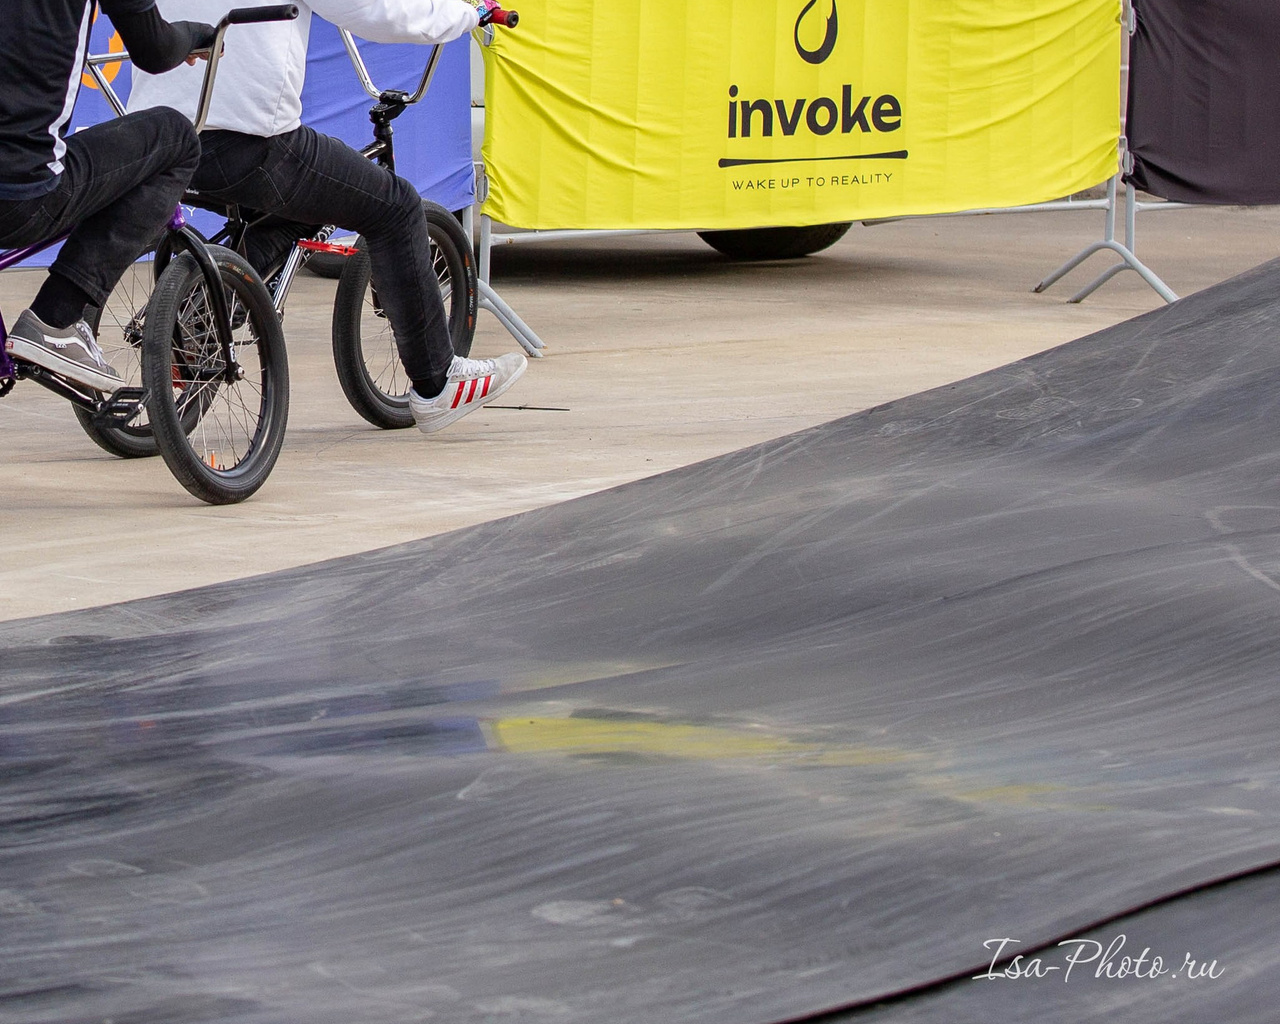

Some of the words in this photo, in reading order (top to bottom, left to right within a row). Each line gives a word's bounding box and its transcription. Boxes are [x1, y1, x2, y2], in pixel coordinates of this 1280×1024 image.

[728, 84, 902, 138] invoke
[732, 179, 776, 190] WAKE
[781, 178, 800, 188] UP
[806, 177, 825, 187] TO
[831, 173, 893, 186] REALITY
